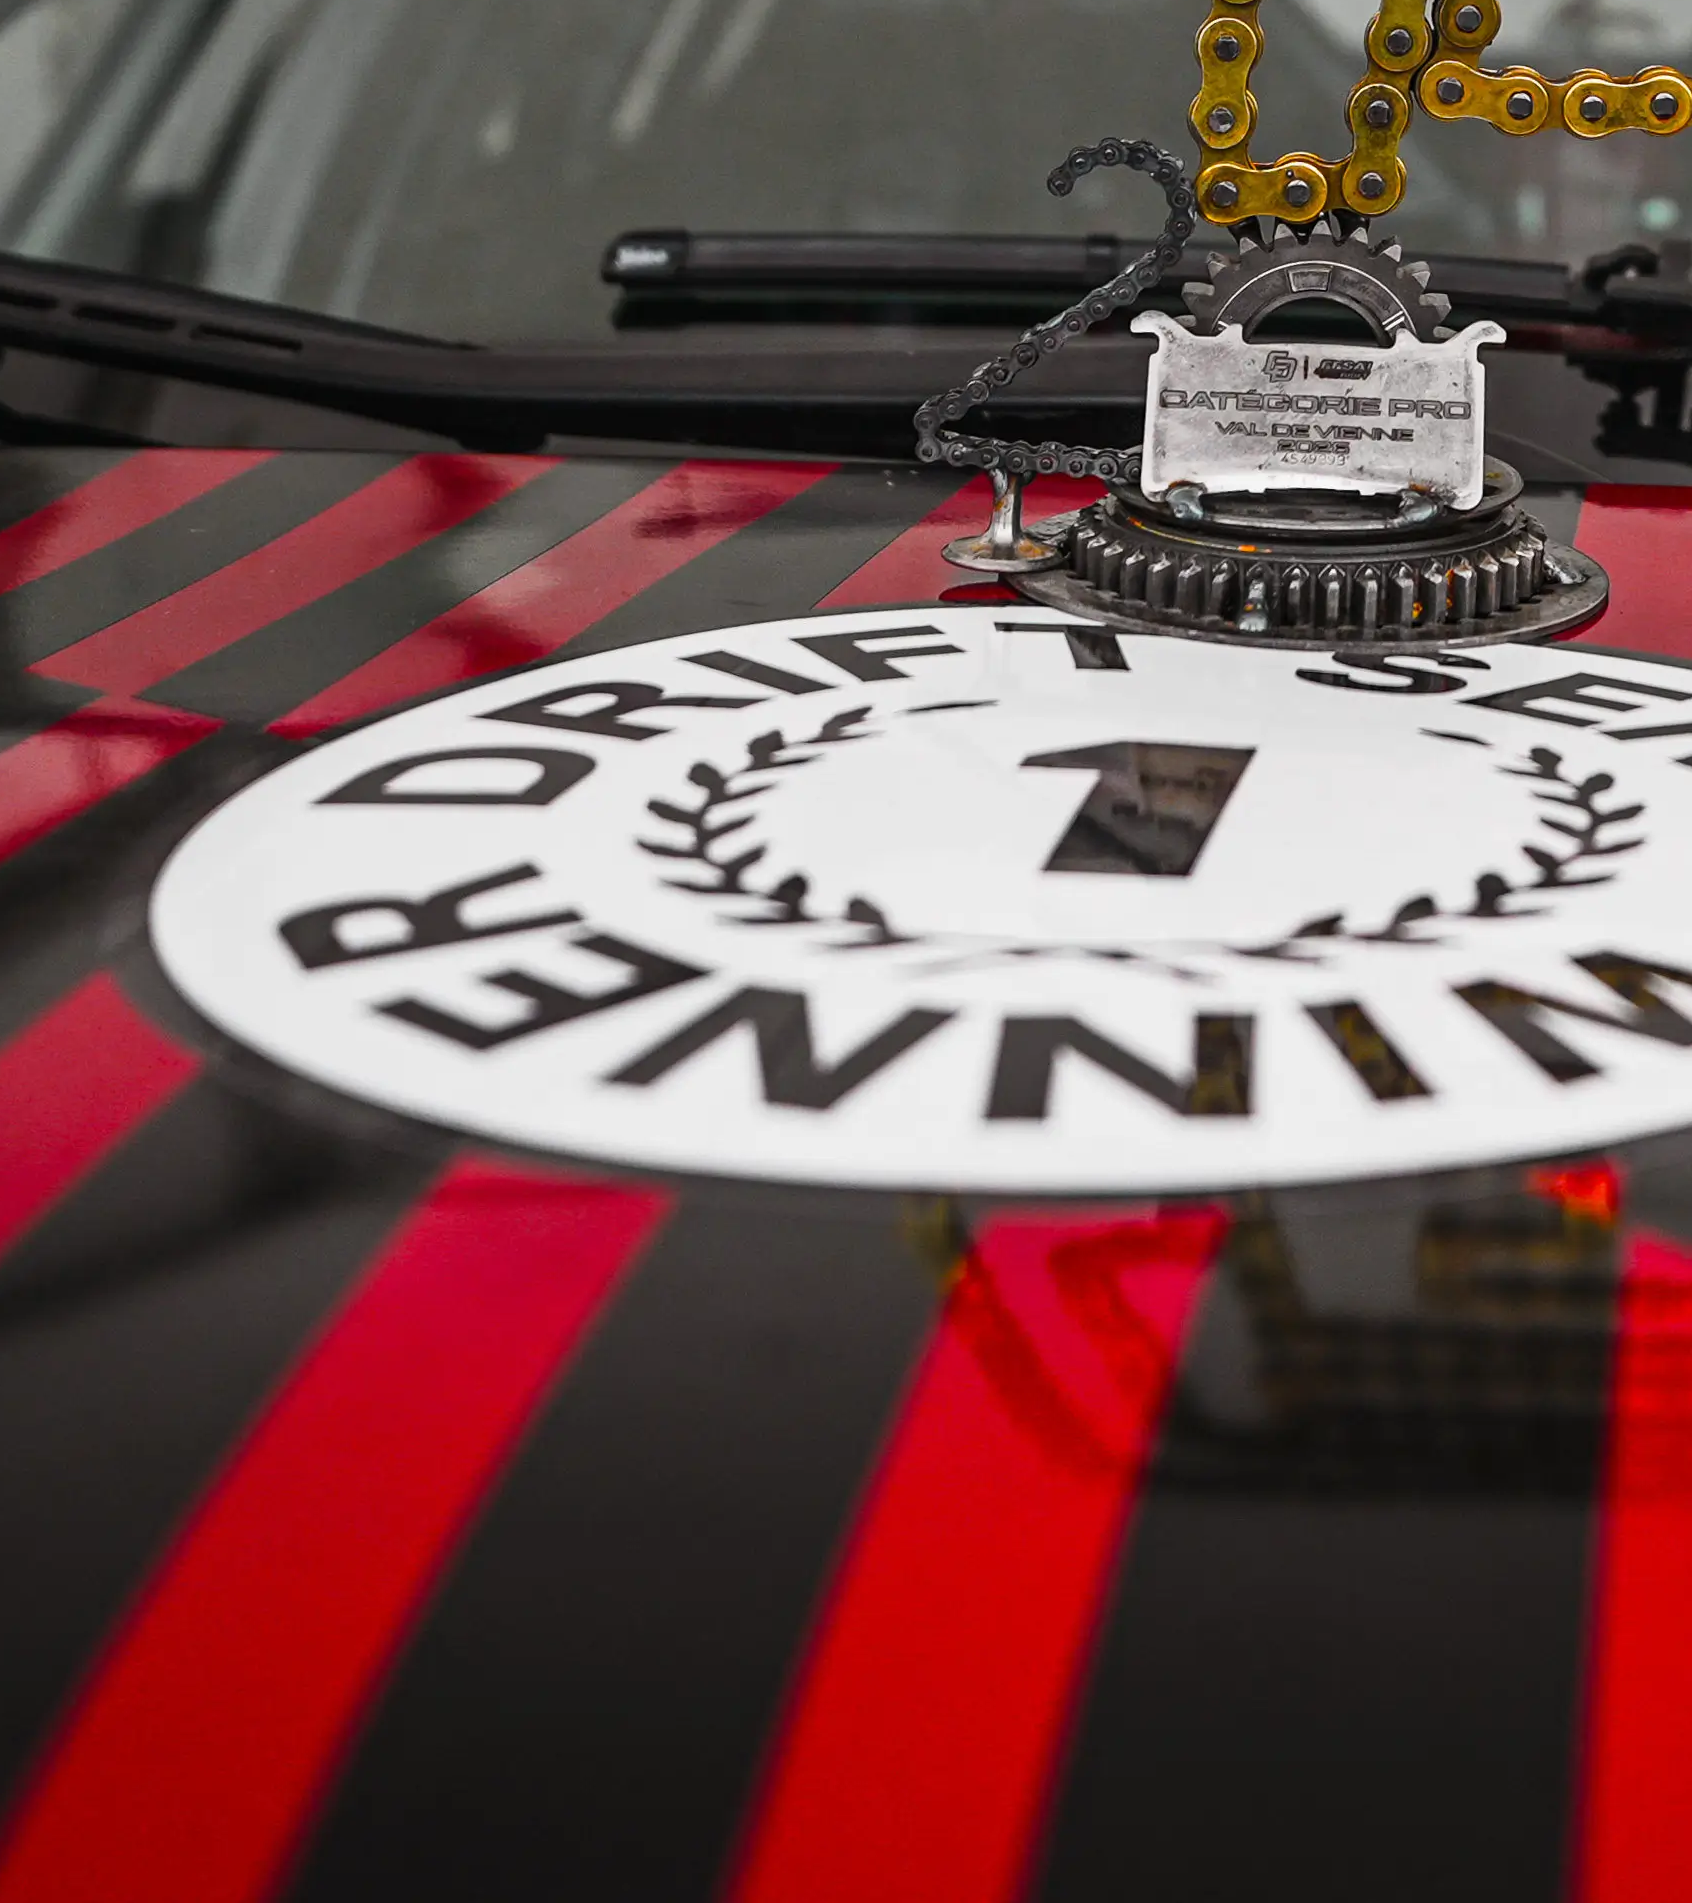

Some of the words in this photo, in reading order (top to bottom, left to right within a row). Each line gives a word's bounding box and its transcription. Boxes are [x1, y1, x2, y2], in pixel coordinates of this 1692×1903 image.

[1159, 388, 1382, 417] CATÉGORIE
[1388, 399, 1472, 420] PRO
[1214, 421, 1268, 437] VAL
[1271, 423, 1310, 438] DE
[1313, 424, 1414, 442] VIENNE
[314, 621, 1132, 809] DRIFT
[1016, 739, 1260, 879] 1
